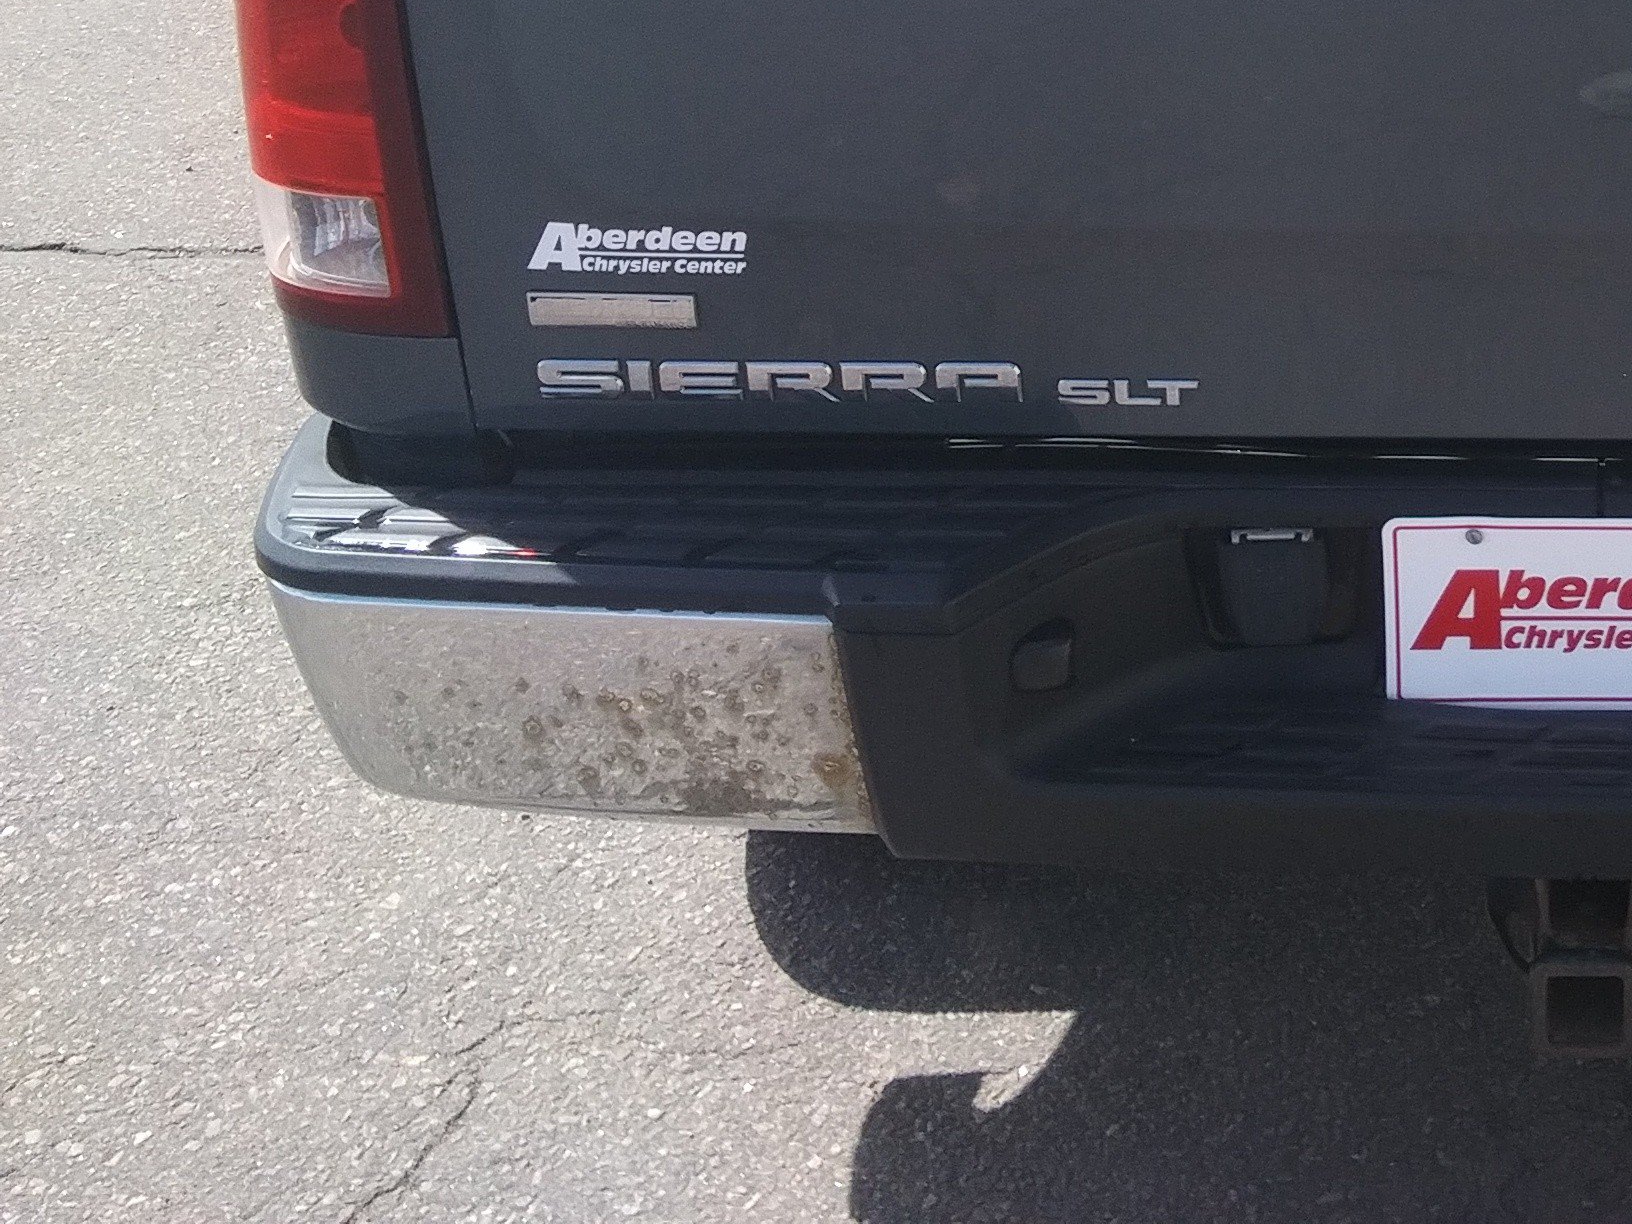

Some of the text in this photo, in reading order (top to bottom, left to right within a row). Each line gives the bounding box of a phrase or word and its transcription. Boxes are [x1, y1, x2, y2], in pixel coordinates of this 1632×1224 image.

[527, 221, 748, 272] Aberdeen
[581, 256, 747, 276] Chrysler Center
[536, 359, 1200, 406] SIERRA SLT
